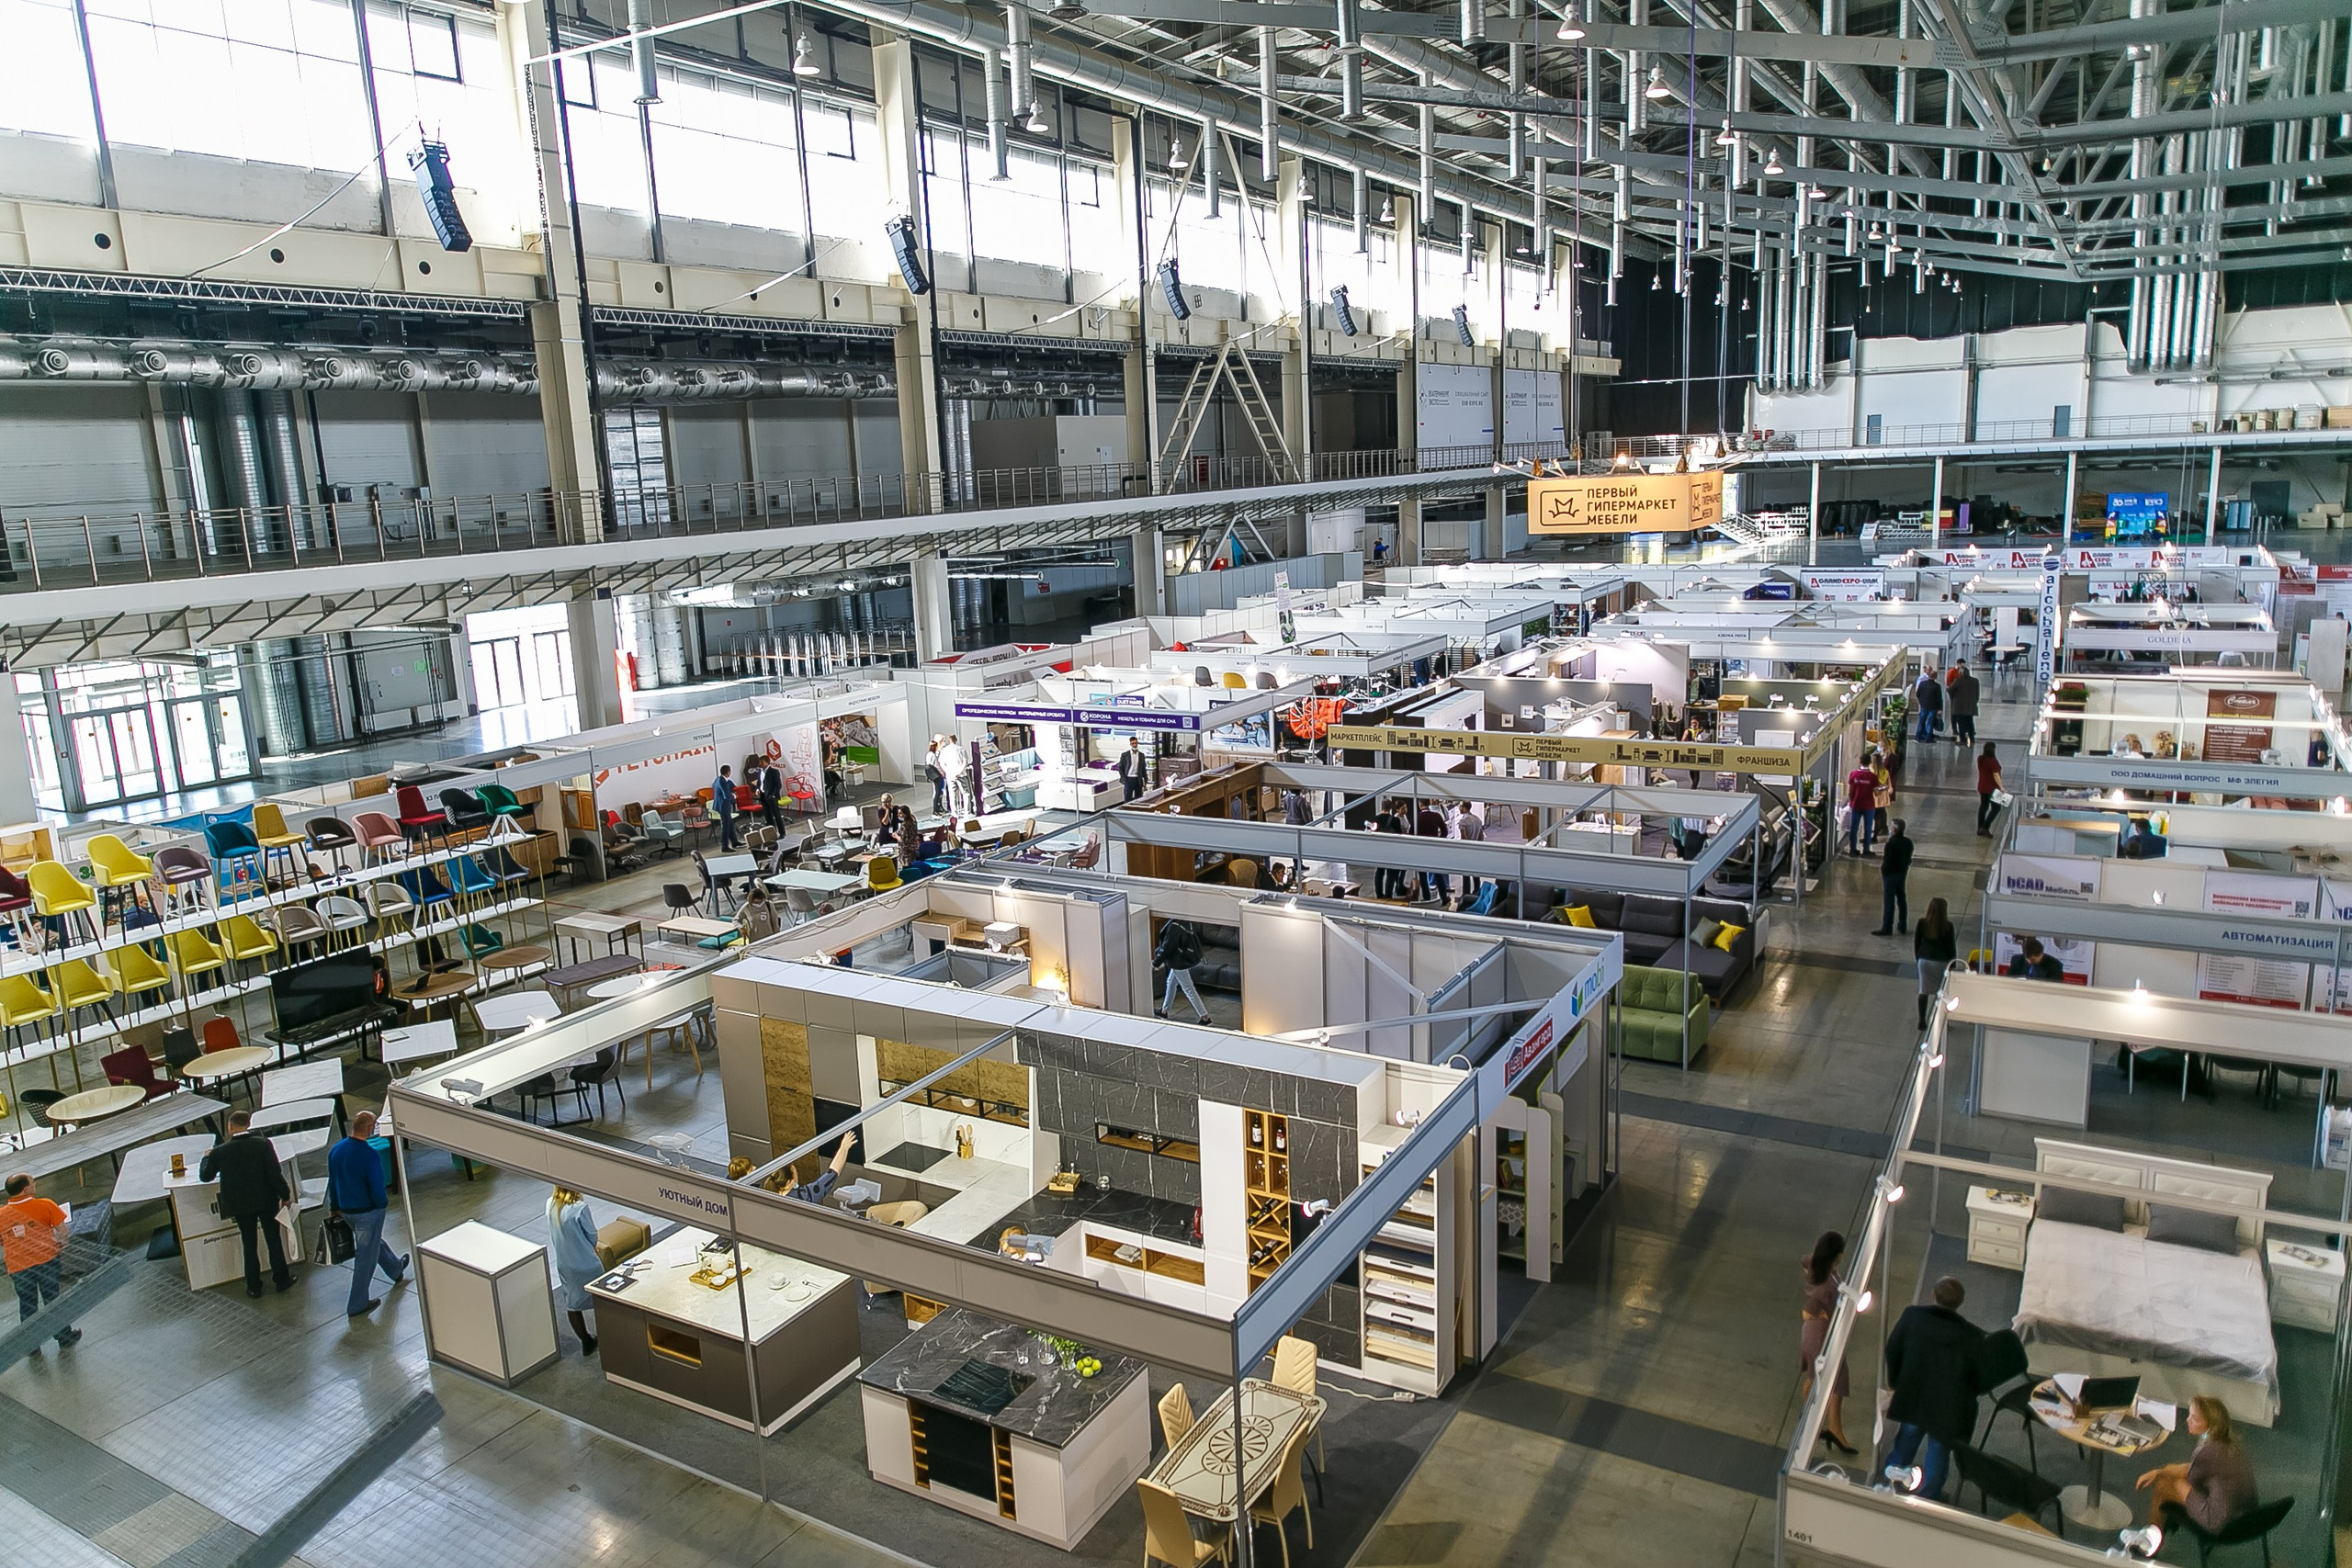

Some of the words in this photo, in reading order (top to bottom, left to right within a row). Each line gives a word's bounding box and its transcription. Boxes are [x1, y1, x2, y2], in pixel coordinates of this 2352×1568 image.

[1587, 485, 1637, 499] ПЕРВЫЙ
[1587, 499, 1677, 512] ГИПЕРМАРКЕТ
[1587, 513, 1637, 525] МЕБЕЛИ
[2040, 575, 2055, 682] arcobaleno
[693, 733, 712, 741] TETCHAIR
[1330, 732, 1382, 743] МАРКЕТПЛЕЙС
[1535, 745, 1581, 753] ГИПЕРМАРКЕТ
[1736, 756, 1791, 766] ФРАНШИЗА
[2110, 770, 2130, 778] ООО
[2132, 771, 2183, 781] ДОМАШНИЙ
[2184, 774, 2220, 783] ВОПРОС
[2227, 776, 2242, 784] МФ
[2245, 778, 2279, 786] ЭЛЕГИЯ
[2007, 875, 2044, 891] bCAD
[2045, 885, 2080, 896] Мебель
[2222, 931, 2334, 950] АВТОМАТИЗАЦИЯ
[1523, 1024, 1553, 1062] Авангард
[658, 1187, 703, 1209] УЮТНЫЙ
[705, 1201, 729, 1217] ДОМ
[1788, 1529, 1813, 1544] 1401
